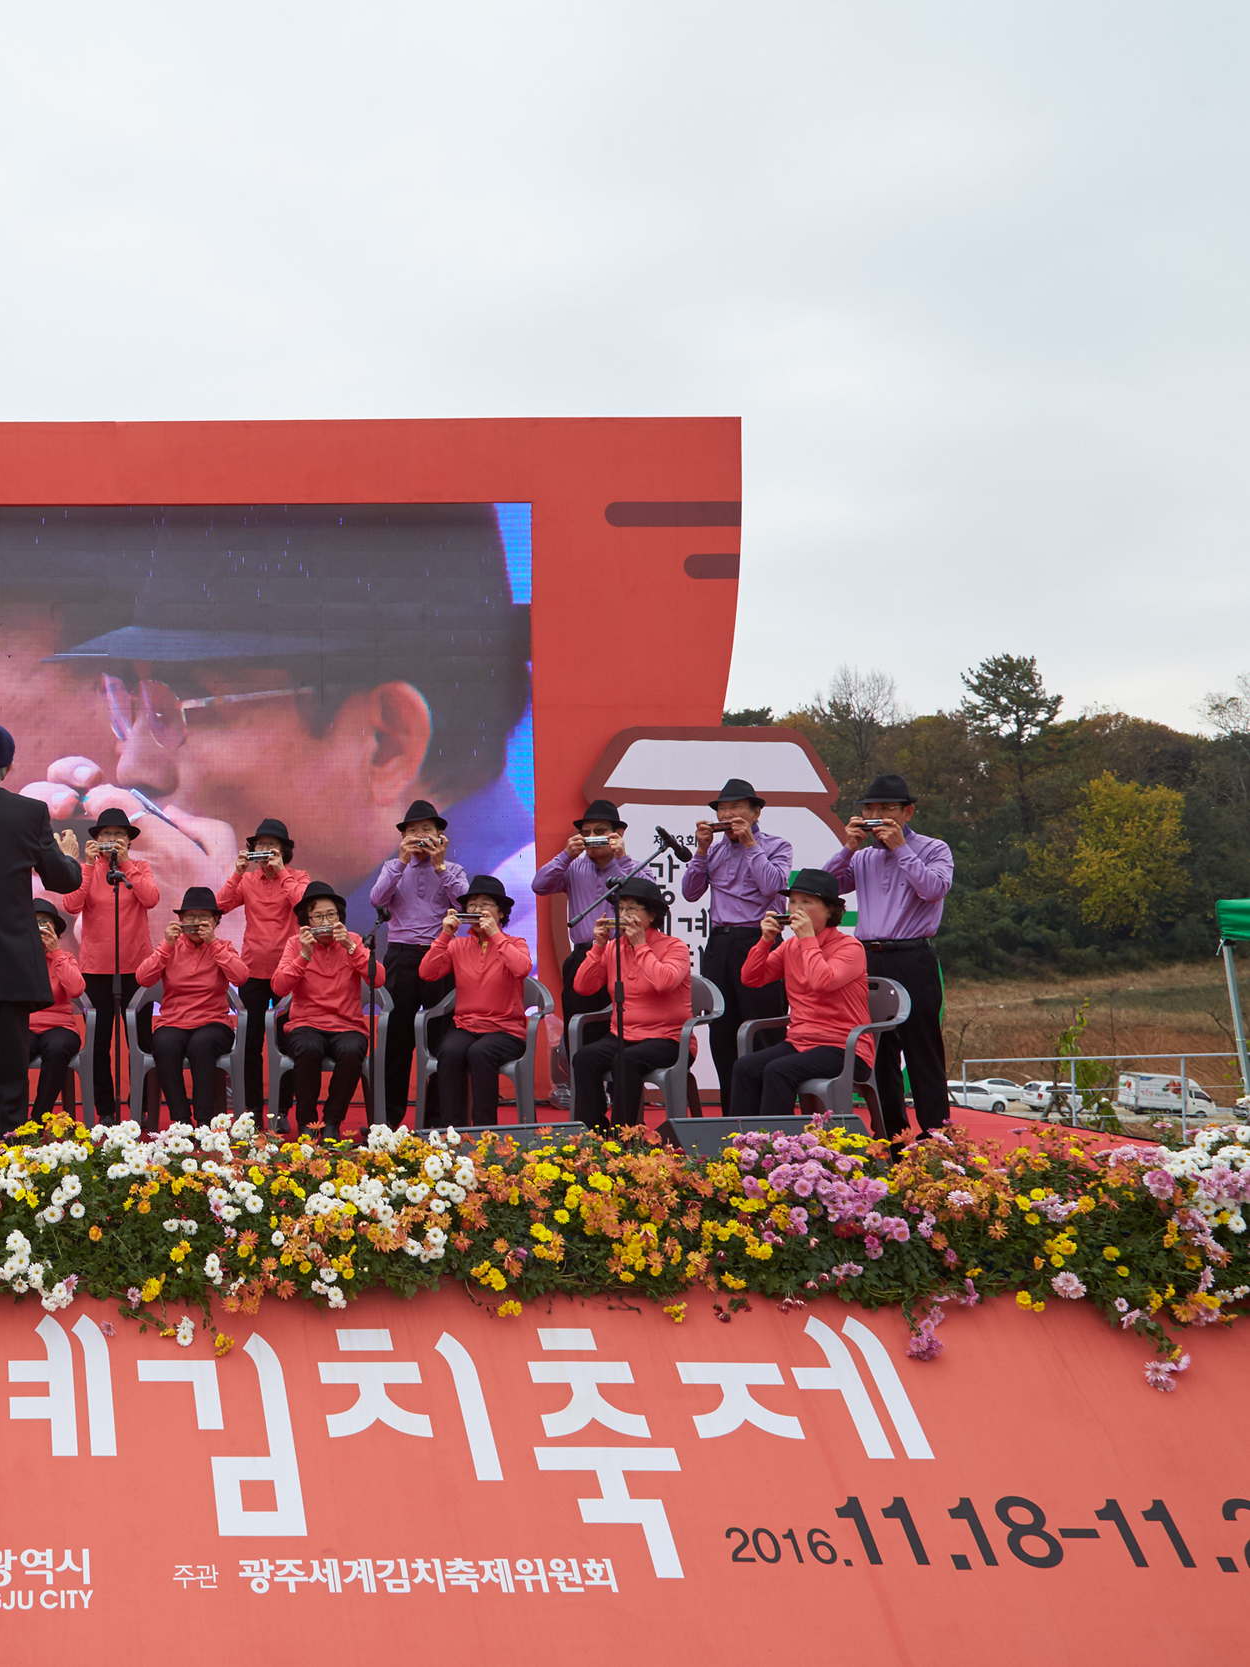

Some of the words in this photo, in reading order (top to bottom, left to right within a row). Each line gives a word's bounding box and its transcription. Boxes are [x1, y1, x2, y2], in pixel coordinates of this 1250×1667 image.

[172, 1563, 219, 1590] 주관
[238, 1557, 620, 1595] 광주세계김치축제위원회
[39, 1589, 94, 1610] CITY
